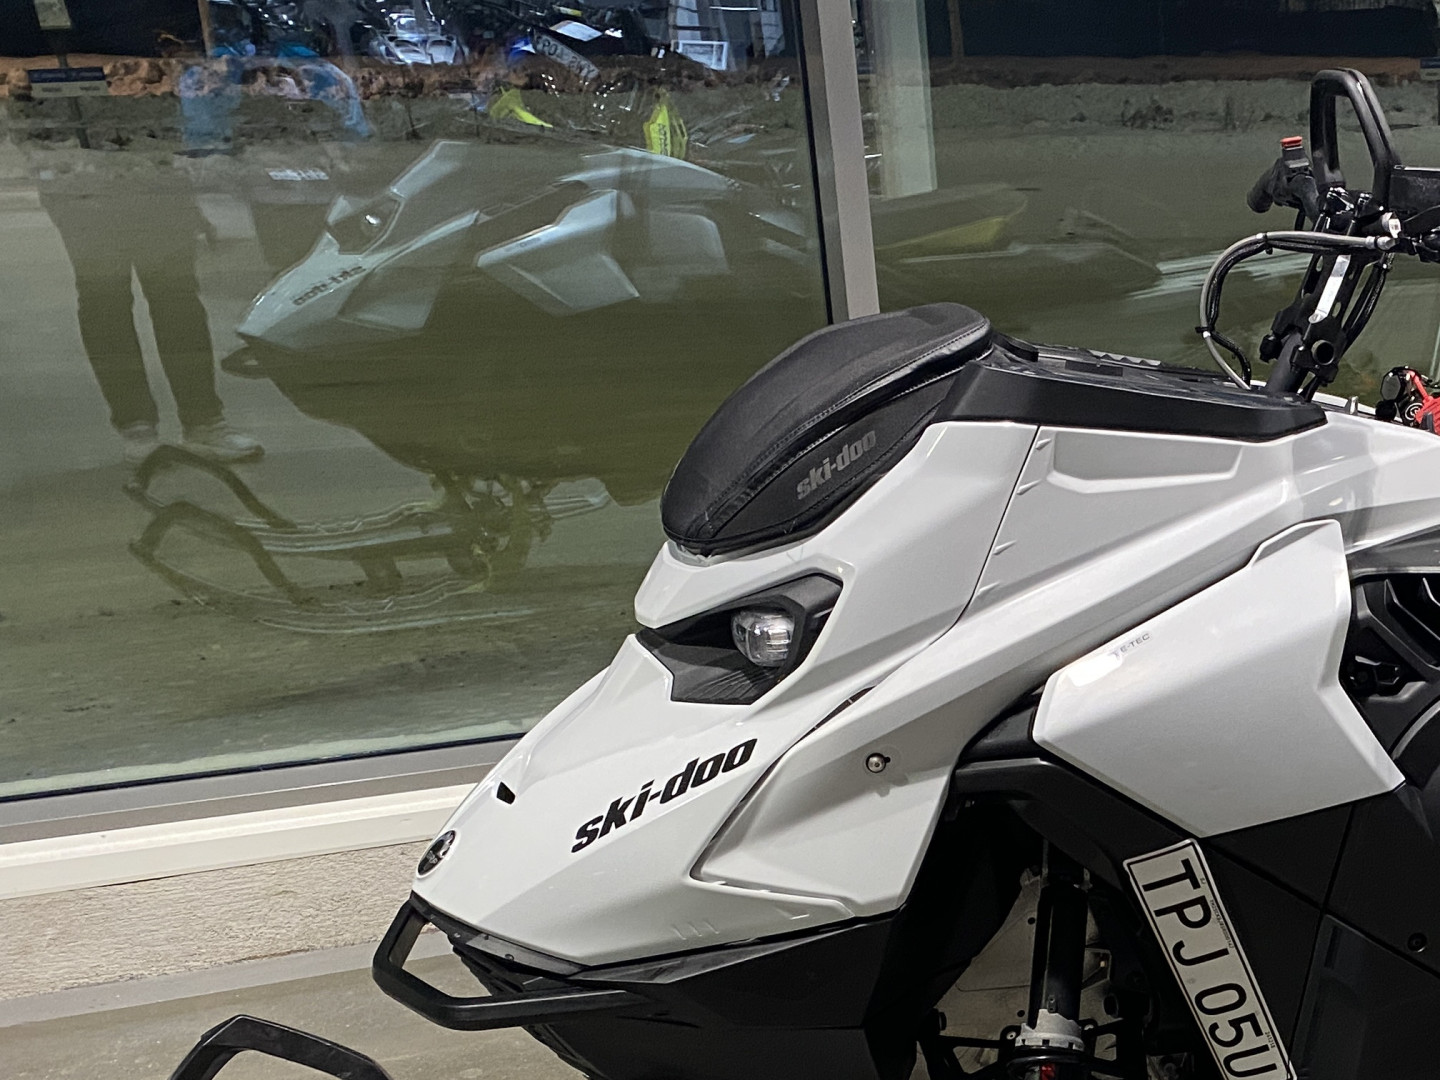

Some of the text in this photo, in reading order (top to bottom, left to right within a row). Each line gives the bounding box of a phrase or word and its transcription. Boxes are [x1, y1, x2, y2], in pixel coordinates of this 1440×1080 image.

[797, 430, 876, 499] ski-doo
[1120, 633, 1150, 653] E-TEC
[571, 738, 758, 853] ski-doo
[1142, 858, 1278, 1078] TPJ 05U
